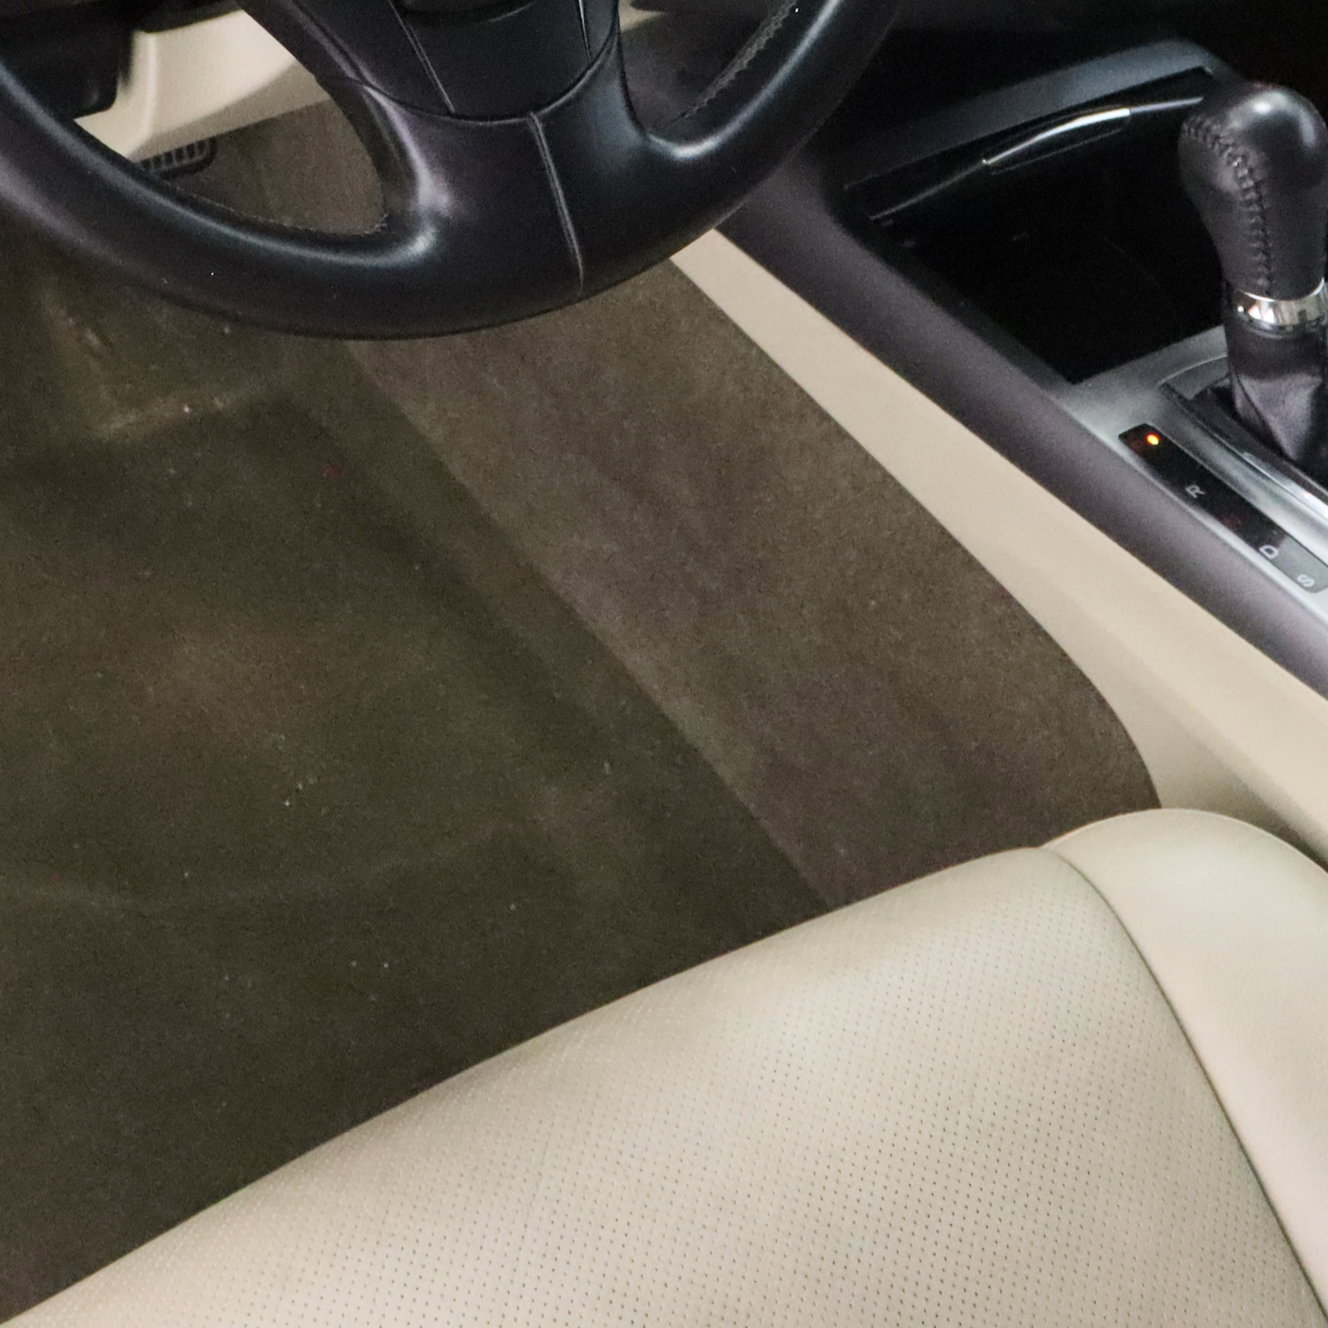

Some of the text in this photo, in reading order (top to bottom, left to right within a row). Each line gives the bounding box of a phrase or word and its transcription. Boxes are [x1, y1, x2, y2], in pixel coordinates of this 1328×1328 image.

[1185, 485, 1206, 499] R
[1259, 544, 1279, 560] D
[1297, 574, 1315, 587] S
